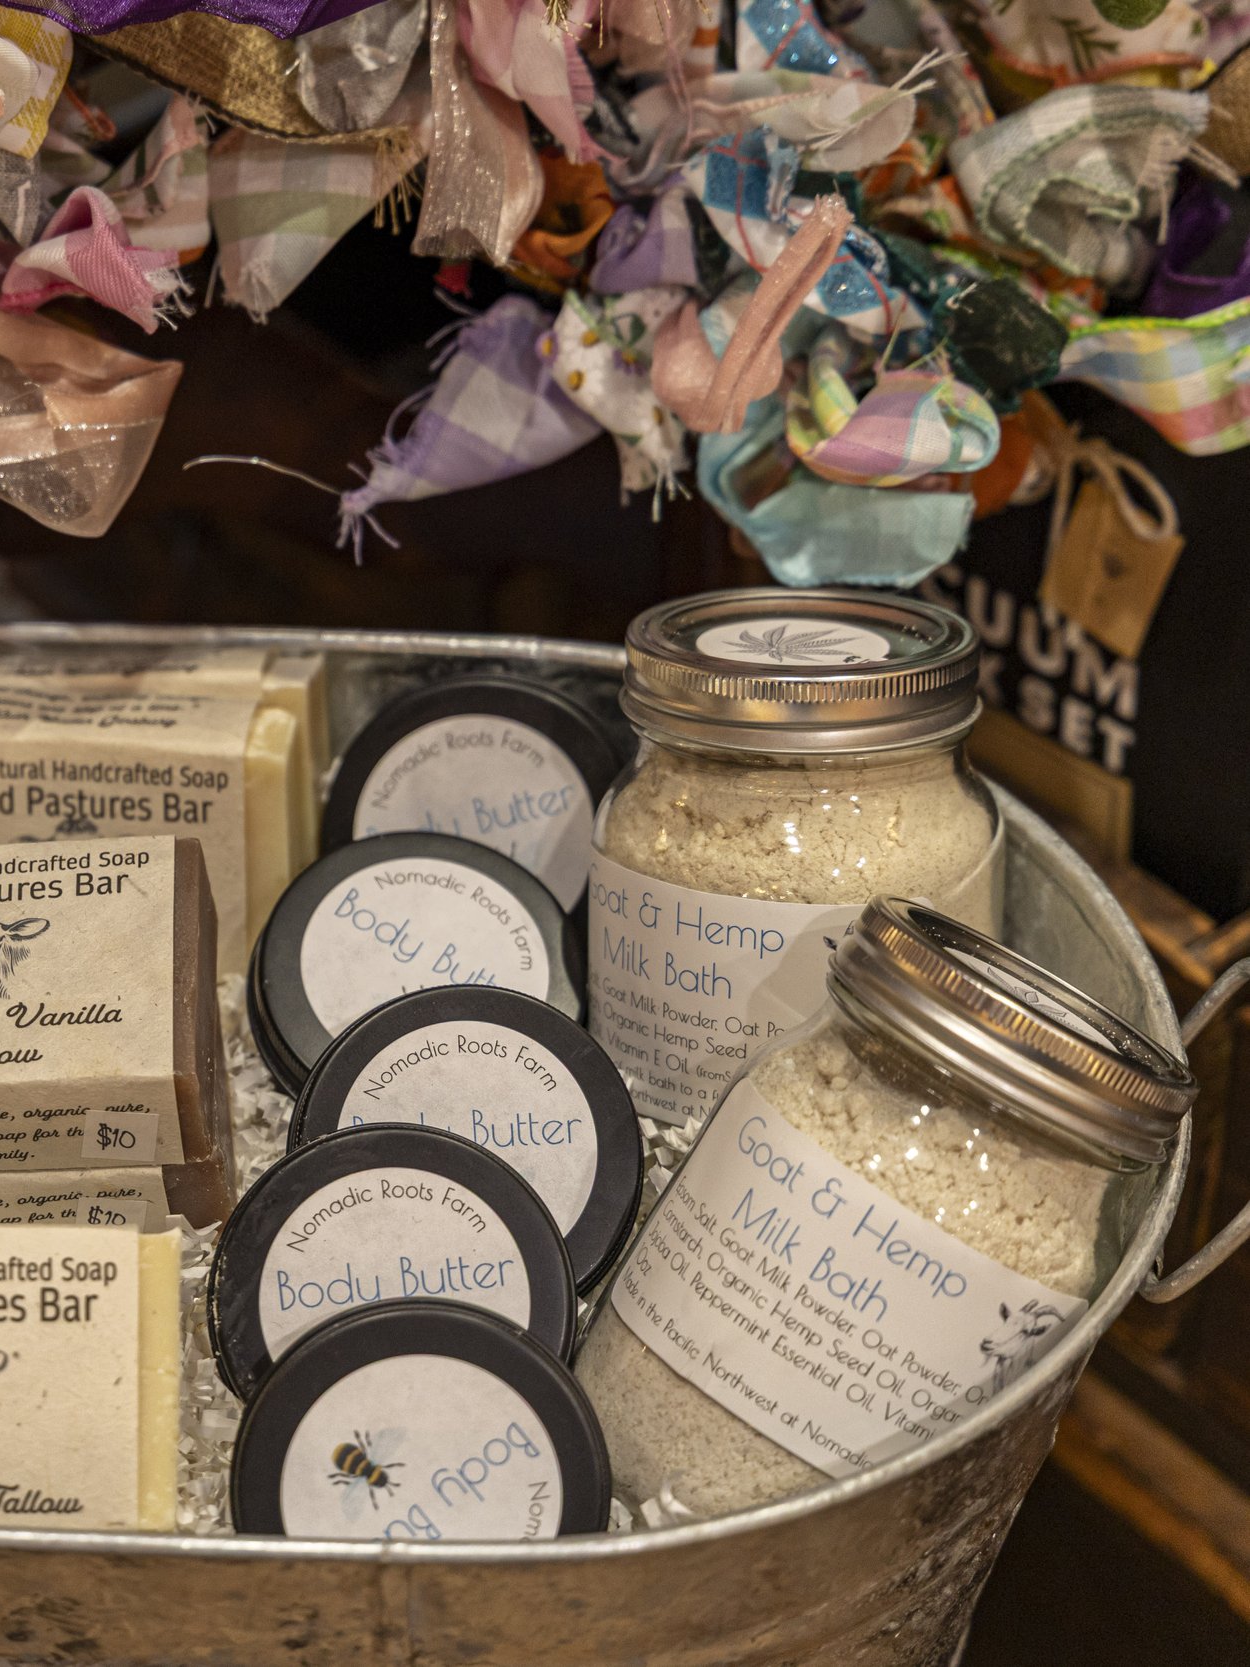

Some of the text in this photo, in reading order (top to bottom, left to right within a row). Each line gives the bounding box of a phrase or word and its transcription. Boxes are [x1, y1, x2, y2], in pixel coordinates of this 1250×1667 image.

[52, 761, 172, 787] Handcrafted
[179, 766, 229, 793] Soap
[372, 730, 545, 810] Nomadic Roots Farm
[27, 786, 152, 822] Pastures
[163, 792, 213, 824] Bar
[472, 784, 576, 834] Butter
[74, 870, 130, 898] Bar
[98, 849, 151, 871] Soap
[334, 888, 497, 987] Body Butt
[374, 871, 534, 972] Nomadic Roots Farm
[640, 892, 662, 929] &
[676, 901, 784, 960] Hemp
[603, 926, 732, 999] Milk Bath
[6, 1001, 124, 1030] Vanilla
[602, 977, 626, 1002] Goat
[631, 991, 656, 1015] Milk
[725, 1016, 760, 1037] Oat
[603, 1002, 649, 1038] Organic
[654, 1023, 699, 1053] Hemp
[706, 1036, 747, 1059] Seed
[363, 1034, 558, 1100] Nomadic Roots Farm
[649, 1072, 676, 1092] bath
[680, 1082, 693, 1096] to
[698, 1089, 707, 1100] a
[654, 1050, 661, 1067] E
[666, 1053, 690, 1075] Oil
[22, 1105, 91, 1120] organic
[630, 1088, 677, 1113] orthwest
[682, 1104, 694, 1117] at
[32, 1126, 61, 1142] for
[96, 1122, 137, 1151] $10
[471, 1109, 582, 1148] Butter
[17, 1191, 83, 1206] organic
[28, 1210, 55, 1223] for
[88, 1205, 127, 1226] $10
[286, 1178, 487, 1253] Nomadic Roots Farm
[737, 1116, 968, 1299] Goat & Hemp
[60, 1257, 117, 1287] Soap
[732, 1187, 889, 1322] Milk Bath
[40, 1286, 98, 1323] Bar
[277, 1255, 514, 1312] Body Butter
[720, 1227, 899, 1362] Goat Milk Oat
[690, 1270, 771, 1344] Peppermint
[772, 1334, 844, 1391] Essential
[707, 1251, 876, 1379] Organic Hemp Seed
[644, 1302, 662, 1327] the
[663, 1318, 701, 1360] Pacific
[702, 1351, 779, 1416] Northwest
[780, 1411, 799, 1429] at
[431, 1421, 540, 1507] Body
